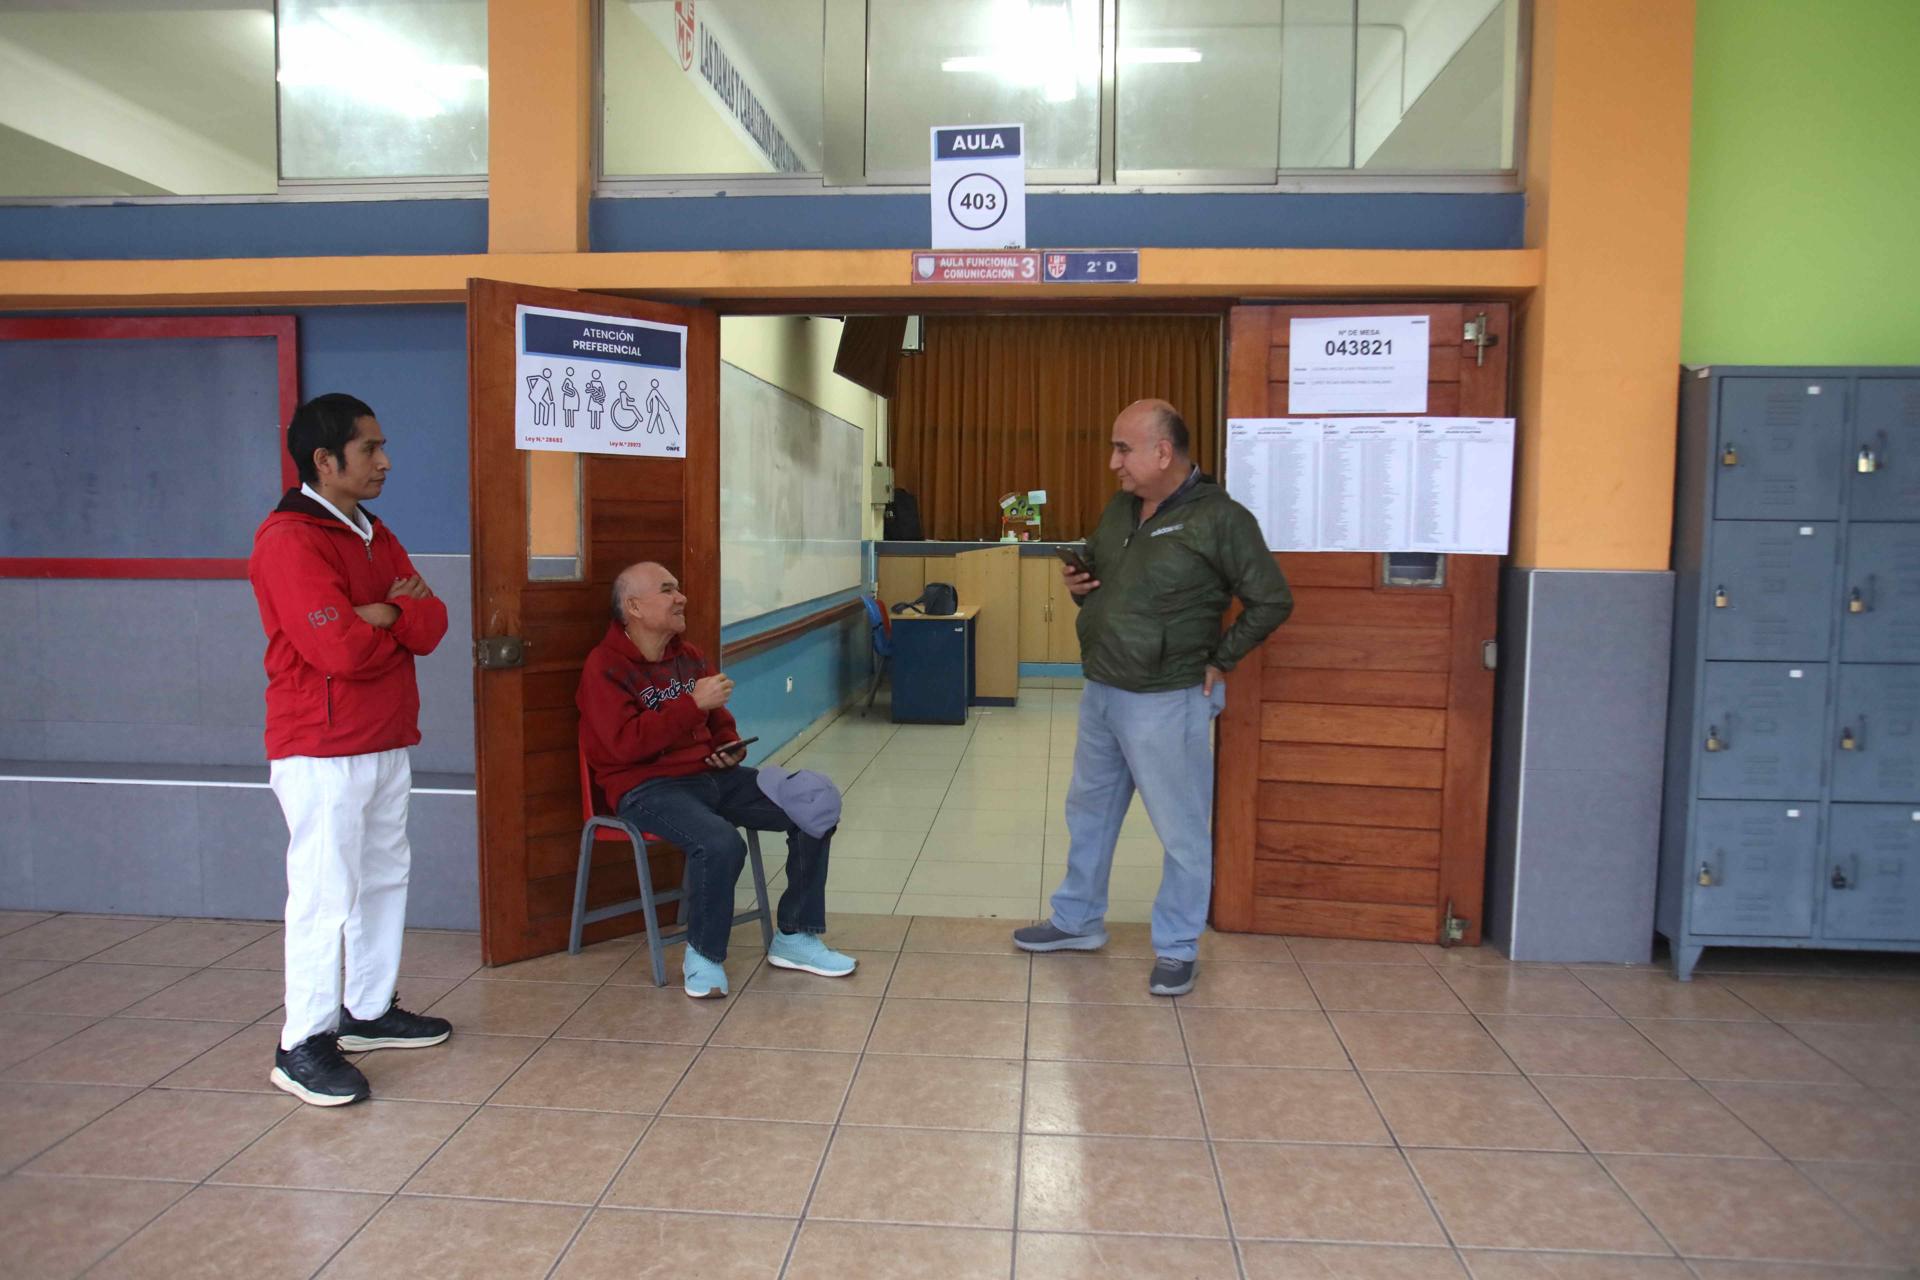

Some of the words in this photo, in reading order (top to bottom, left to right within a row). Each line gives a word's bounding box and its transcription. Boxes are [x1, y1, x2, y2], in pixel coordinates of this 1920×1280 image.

[700, 22, 713, 85] LAS
[713, 41, 734, 112] DAMAS
[952, 134, 1005, 151] AULA
[960, 193, 996, 210] 403
[940, 257, 963, 267] AULA
[966, 257, 1018, 267] FUNCIONAL
[1021, 256, 1035, 278] 3
[1106, 261, 1117, 273] D
[944, 268, 1015, 279] COMUNICACIÓN
[583, 328, 634, 343] ATENCIÓN
[573, 340, 642, 357] PREFERENCIAL
[1325, 339, 1393, 356] 043821
[525, 435, 535, 443] Ley
